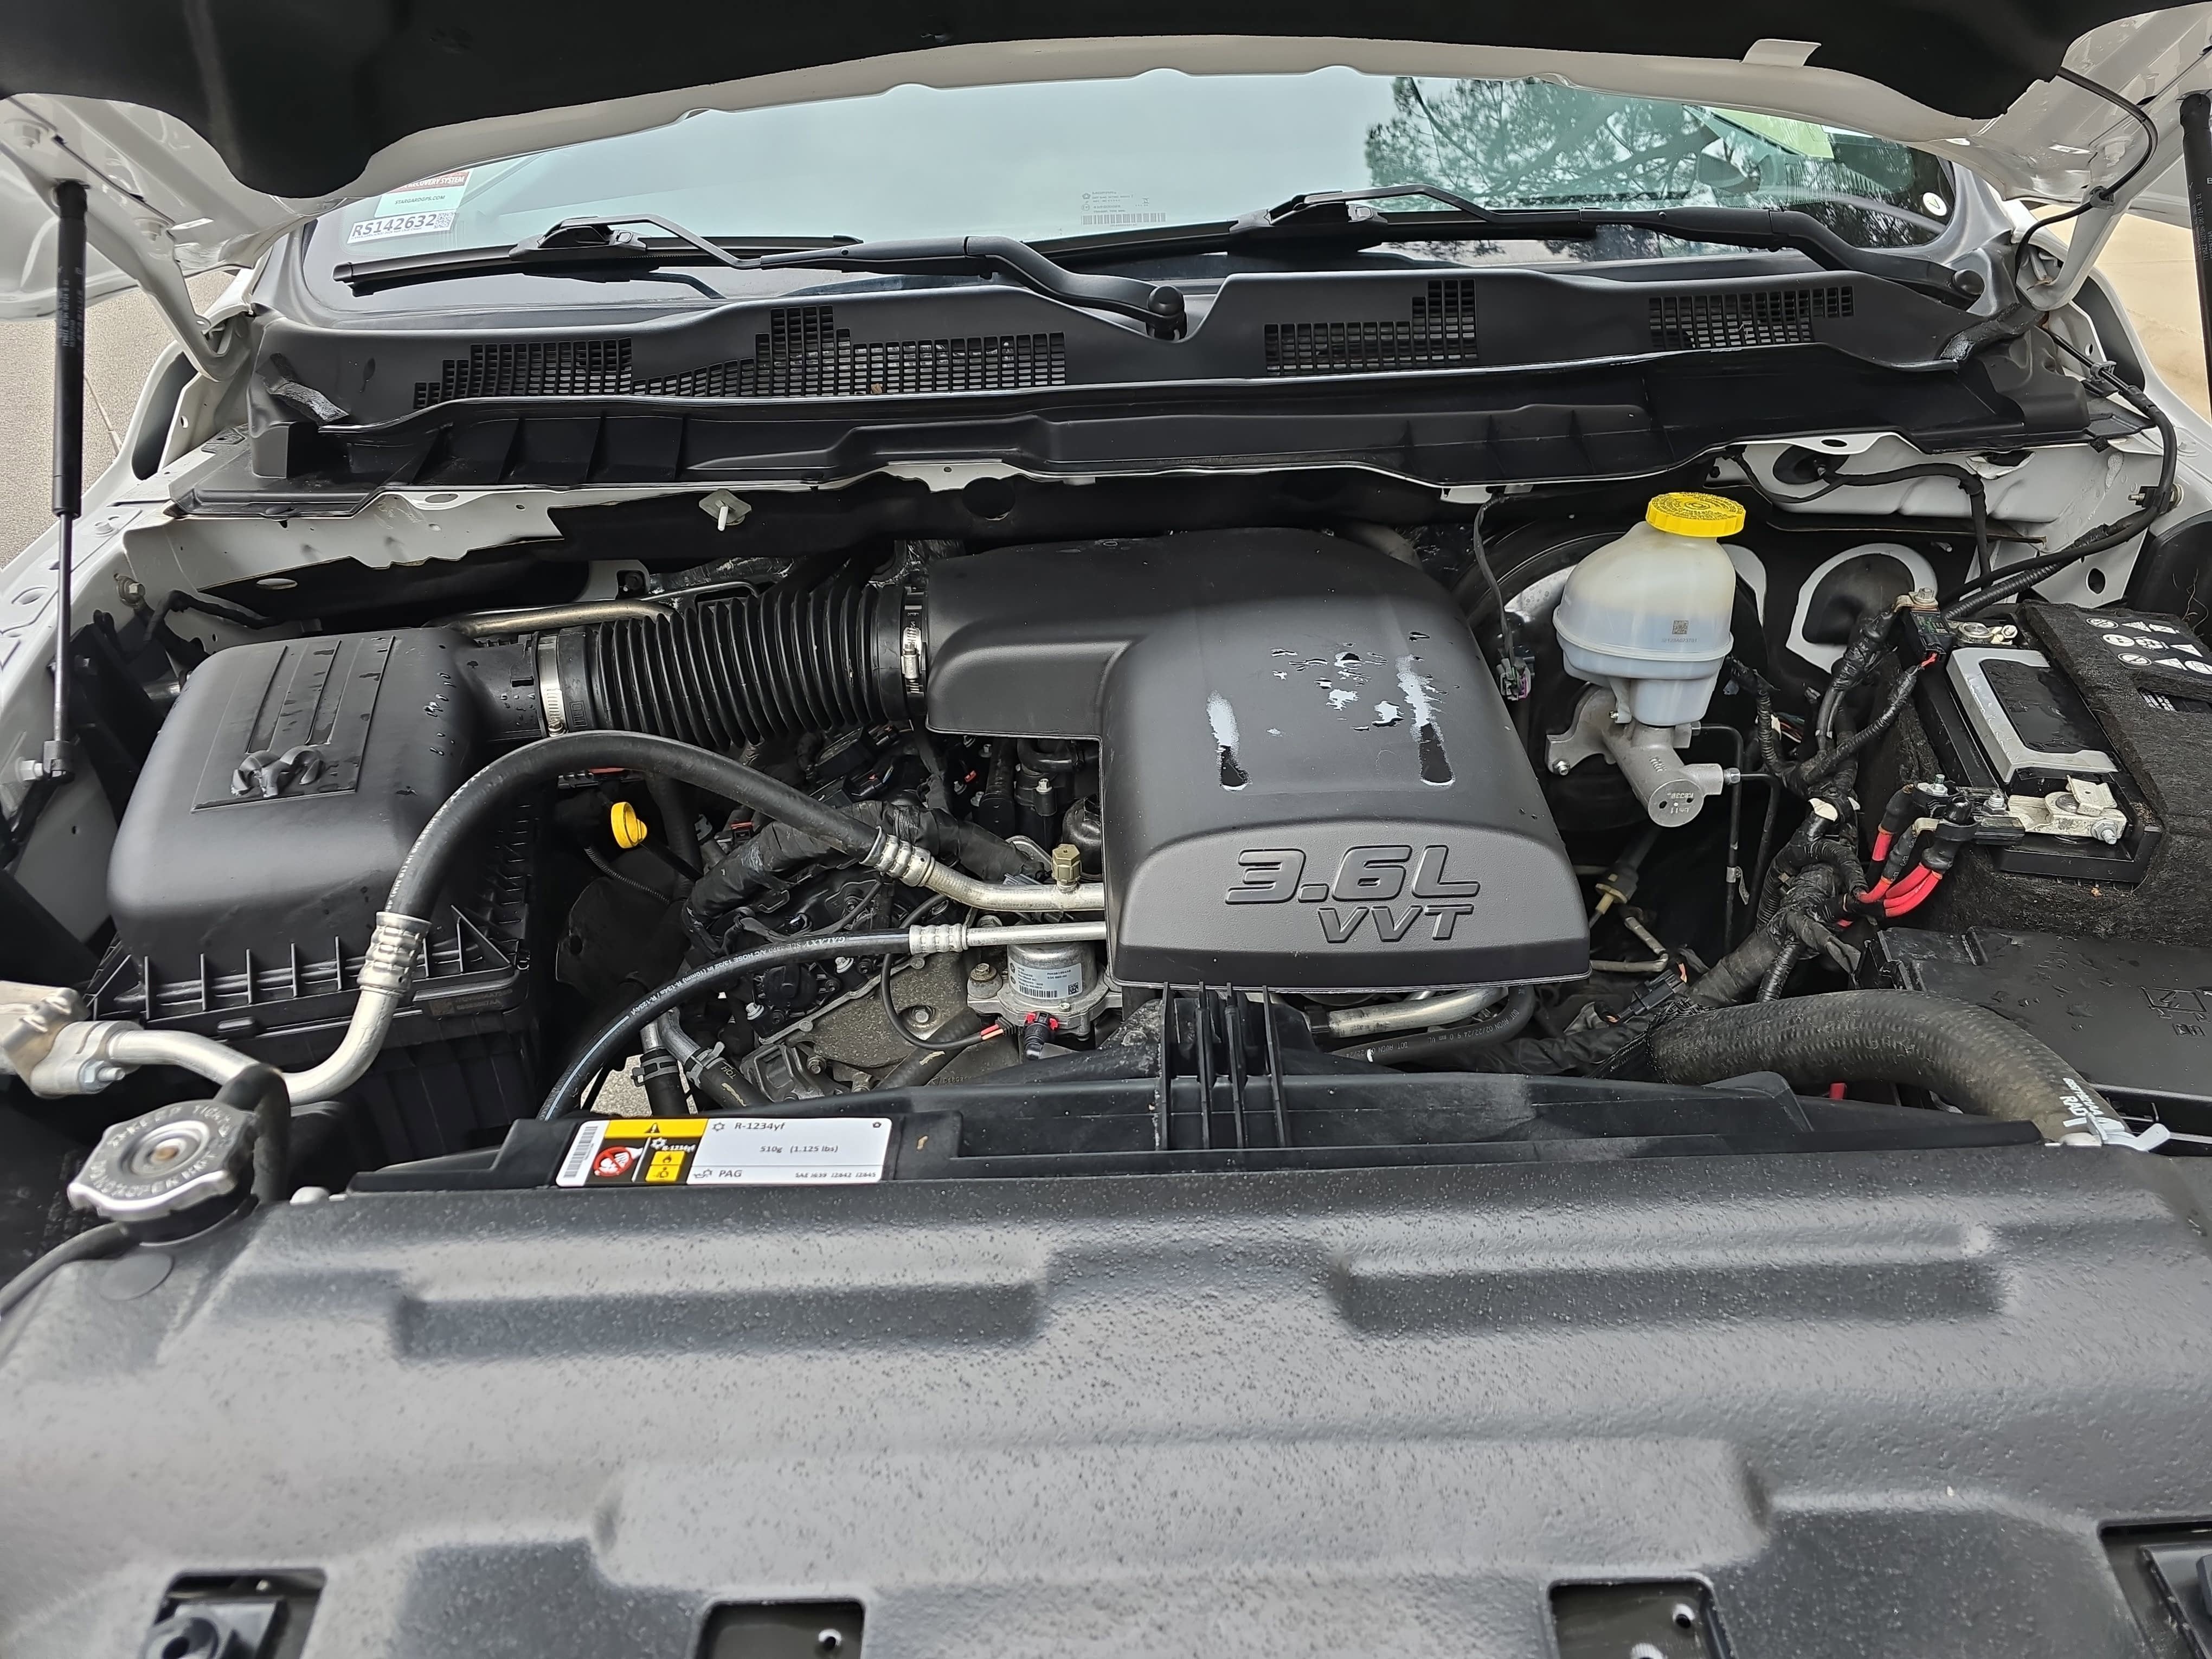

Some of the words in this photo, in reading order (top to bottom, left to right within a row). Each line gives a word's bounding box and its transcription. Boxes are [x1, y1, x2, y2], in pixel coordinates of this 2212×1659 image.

[440, 176, 465, 184] SYSTEM
[395, 195, 446, 204] STARGARDGPS.COM
[352, 214, 437, 237] RS142632
[1225, 844, 1481, 905] 3.6L
[1317, 904, 1474, 943] VVT
[805, 936, 846, 947] GALAXY
[733, 952, 754, 963] HOSE
[754, 949, 767, 957] A/C
[714, 959, 734, 969] 13/32
[685, 967, 707, 984] (10mm)
[661, 979, 683, 996] R-134a
[629, 994, 658, 1017] R-1234yf
[734, 1122, 786, 1131] R-1234yf
[790, 1146, 819, 1154] (1.125
[718, 1169, 743, 1178] PAG
